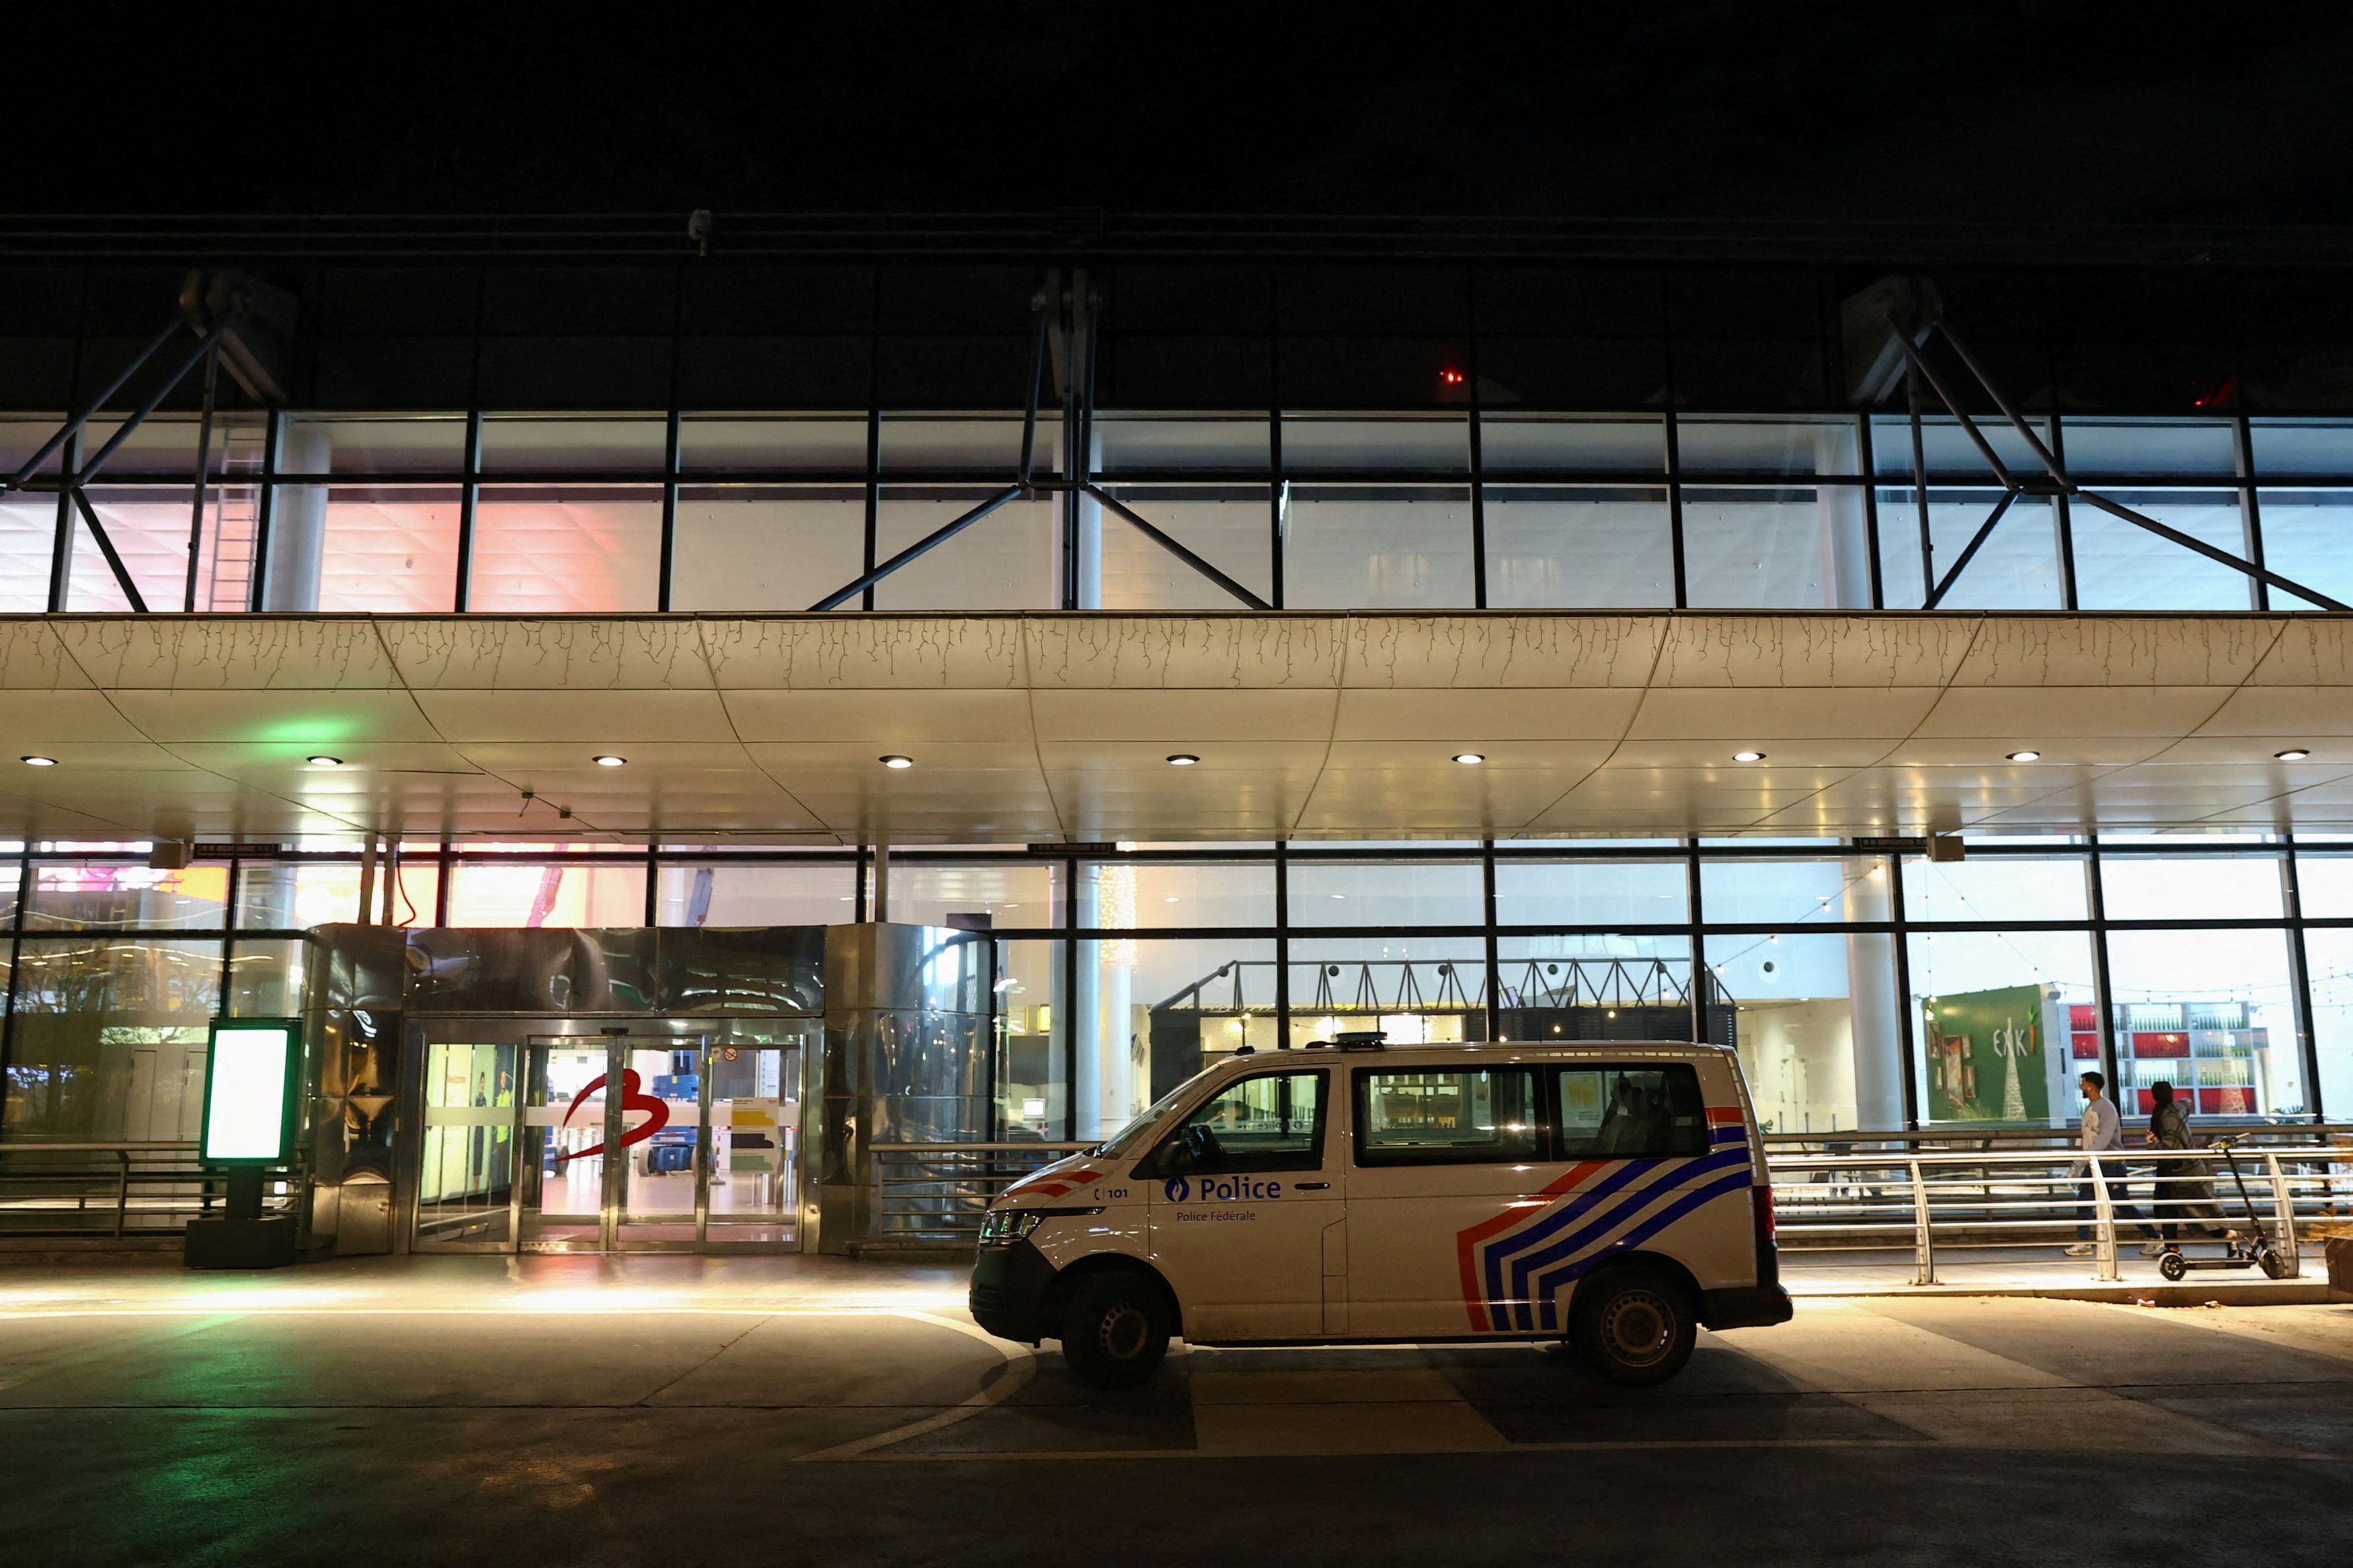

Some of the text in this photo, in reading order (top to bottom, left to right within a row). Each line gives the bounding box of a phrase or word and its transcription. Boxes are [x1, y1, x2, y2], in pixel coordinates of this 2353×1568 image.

[1108, 1189, 1128, 1198] 101
[1201, 1176, 1281, 1200] Police
[1177, 1210, 1256, 1221] Police Fédérale
